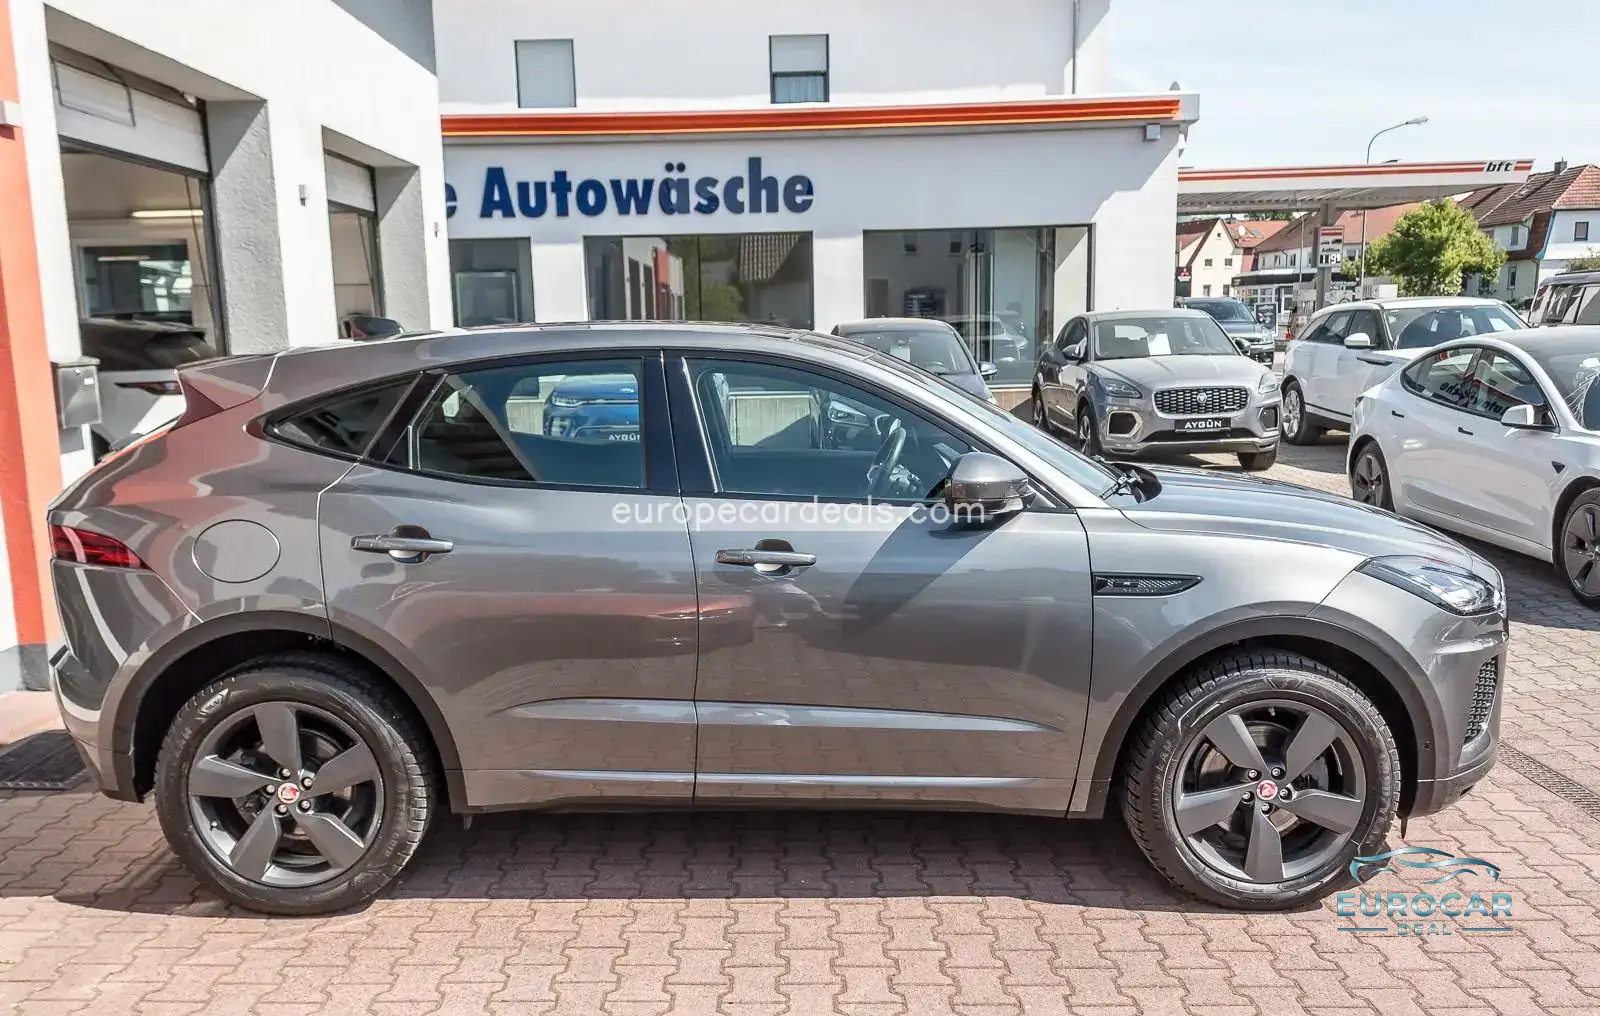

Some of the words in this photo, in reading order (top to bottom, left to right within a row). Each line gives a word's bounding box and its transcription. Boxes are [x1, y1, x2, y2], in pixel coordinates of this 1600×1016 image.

[1486, 161, 1512, 172] bft
[480, 157, 814, 218] Autowäsche
[1184, 419, 1222, 429] AYGÜN
